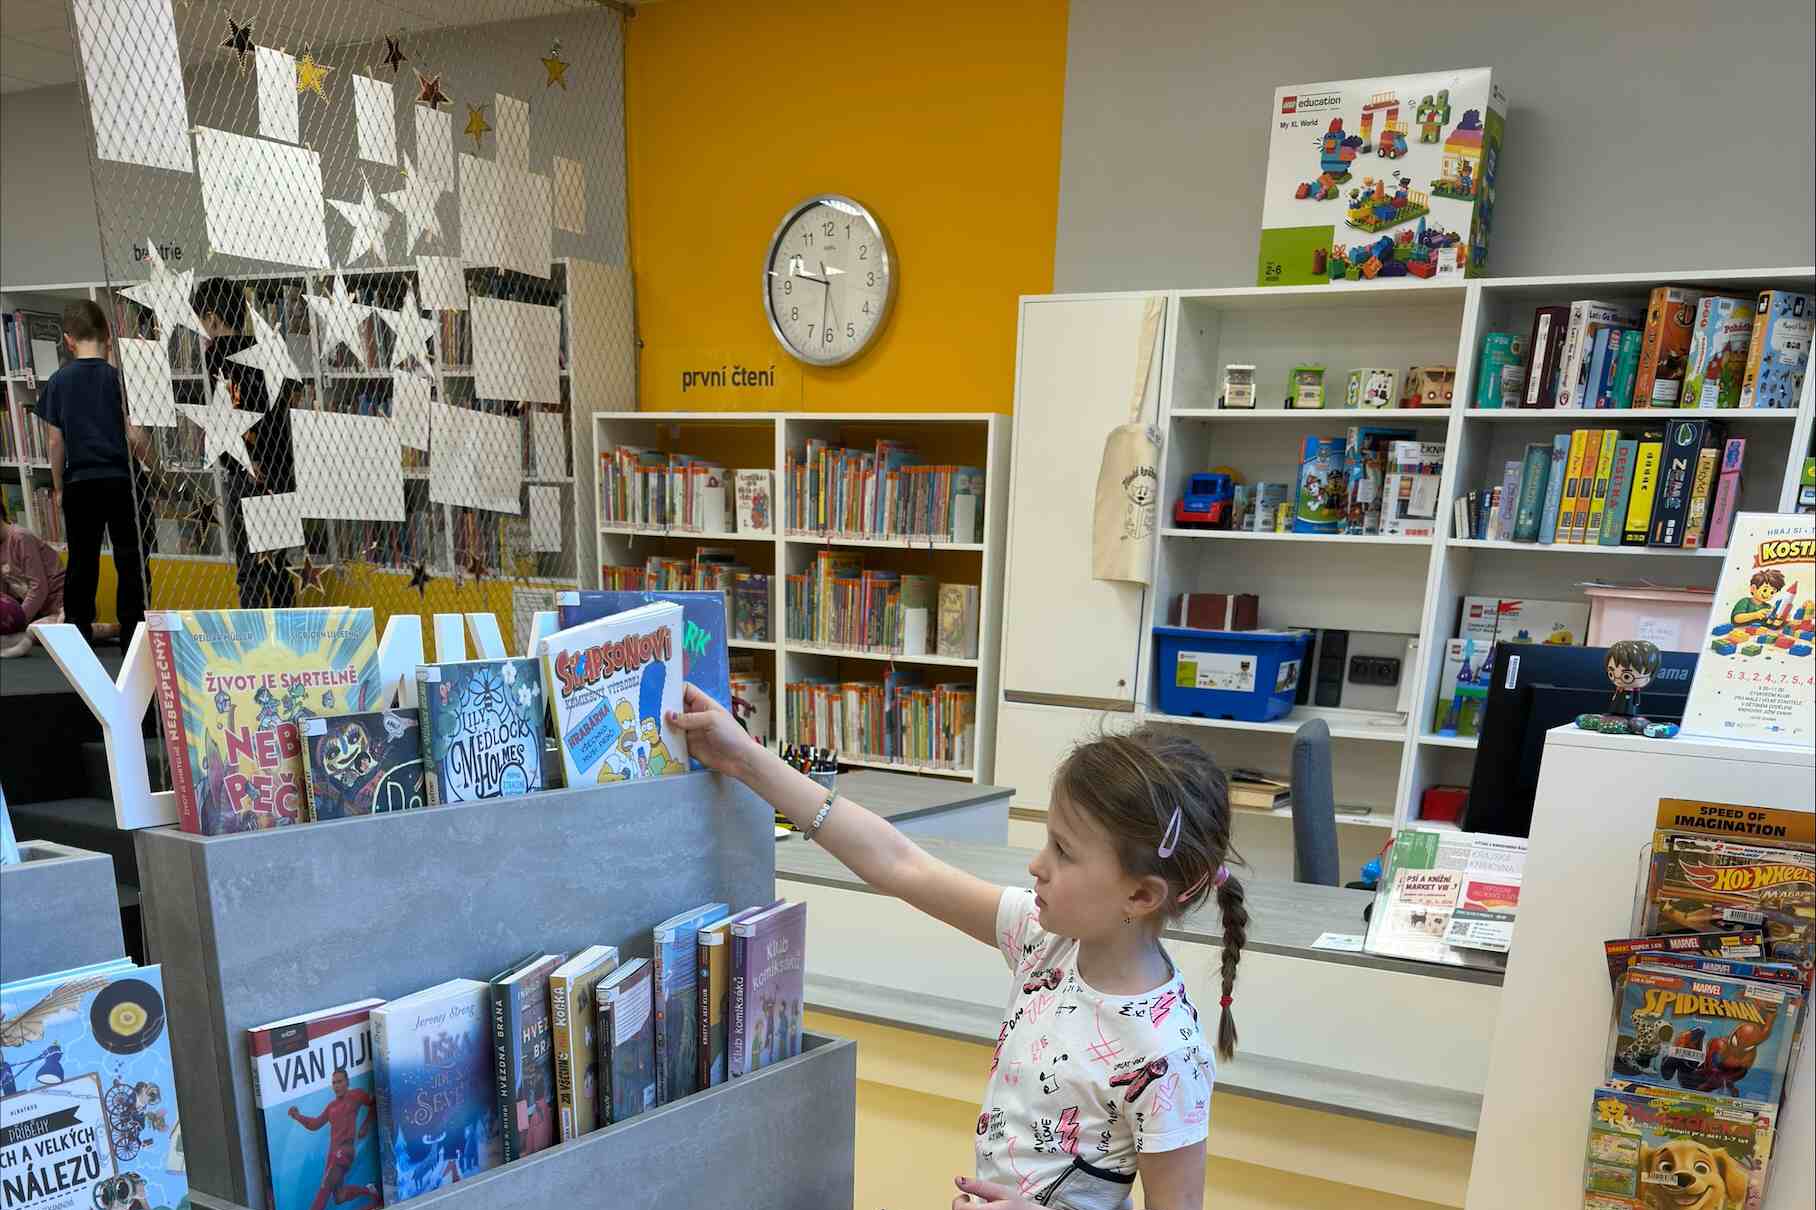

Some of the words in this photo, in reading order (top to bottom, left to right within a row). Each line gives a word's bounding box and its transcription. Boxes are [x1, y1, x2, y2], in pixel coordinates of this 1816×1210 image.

[1298, 96, 1341, 108] education
[1280, 121, 1288, 129] My
[1291, 120, 1299, 128] XL
[1301, 119, 1318, 127] World
[822, 221, 835, 237] 12
[846, 224, 851, 240] 1
[803, 233, 814, 248] 11
[858, 246, 868, 260] 2
[866, 272, 875, 287] 3
[784, 281, 792, 295] 9
[791, 307, 799, 321] 8
[862, 301, 870, 315] 4
[807, 324, 815, 339] 7
[825, 328, 834, 343] 6
[846, 323, 855, 337] 5
[682, 366, 726, 392] první
[732, 365, 776, 387] čtení
[206, 671, 256, 695] ŽIVOT
[261, 673, 277, 689] JE
[280, 665, 358, 689] SMRTELNĚ
[1657, 666, 1688, 680] ama
[459, 708, 486, 733] LILY
[223, 722, 301, 770] NEB
[476, 744, 525, 799] HOLMES
[224, 772, 300, 820] PEČ
[1700, 806, 1744, 819] SPEED
[1748, 811, 1766, 821] OF
[1675, 815, 1786, 837] IMAGINATION
[1405, 882, 1436, 890] MARKET
[1670, 937, 1700, 949] MARVEL
[1702, 962, 1731, 973] MARVEL
[1692, 982, 1721, 995] MARVEL
[1642, 988, 1767, 1024] SPIDER-MAN
[273, 1048, 326, 1094] VAN
[8, 1119, 49, 1143] PŘÍBĚHY
[1040, 1118, 1054, 1142] LOVE
[0, 1150, 17, 1169] CH
[22, 1145, 33, 1163] A
[35, 1126, 95, 1158] VELKÝCH
[0, 1145, 101, 1210] NÁLEZŮ
